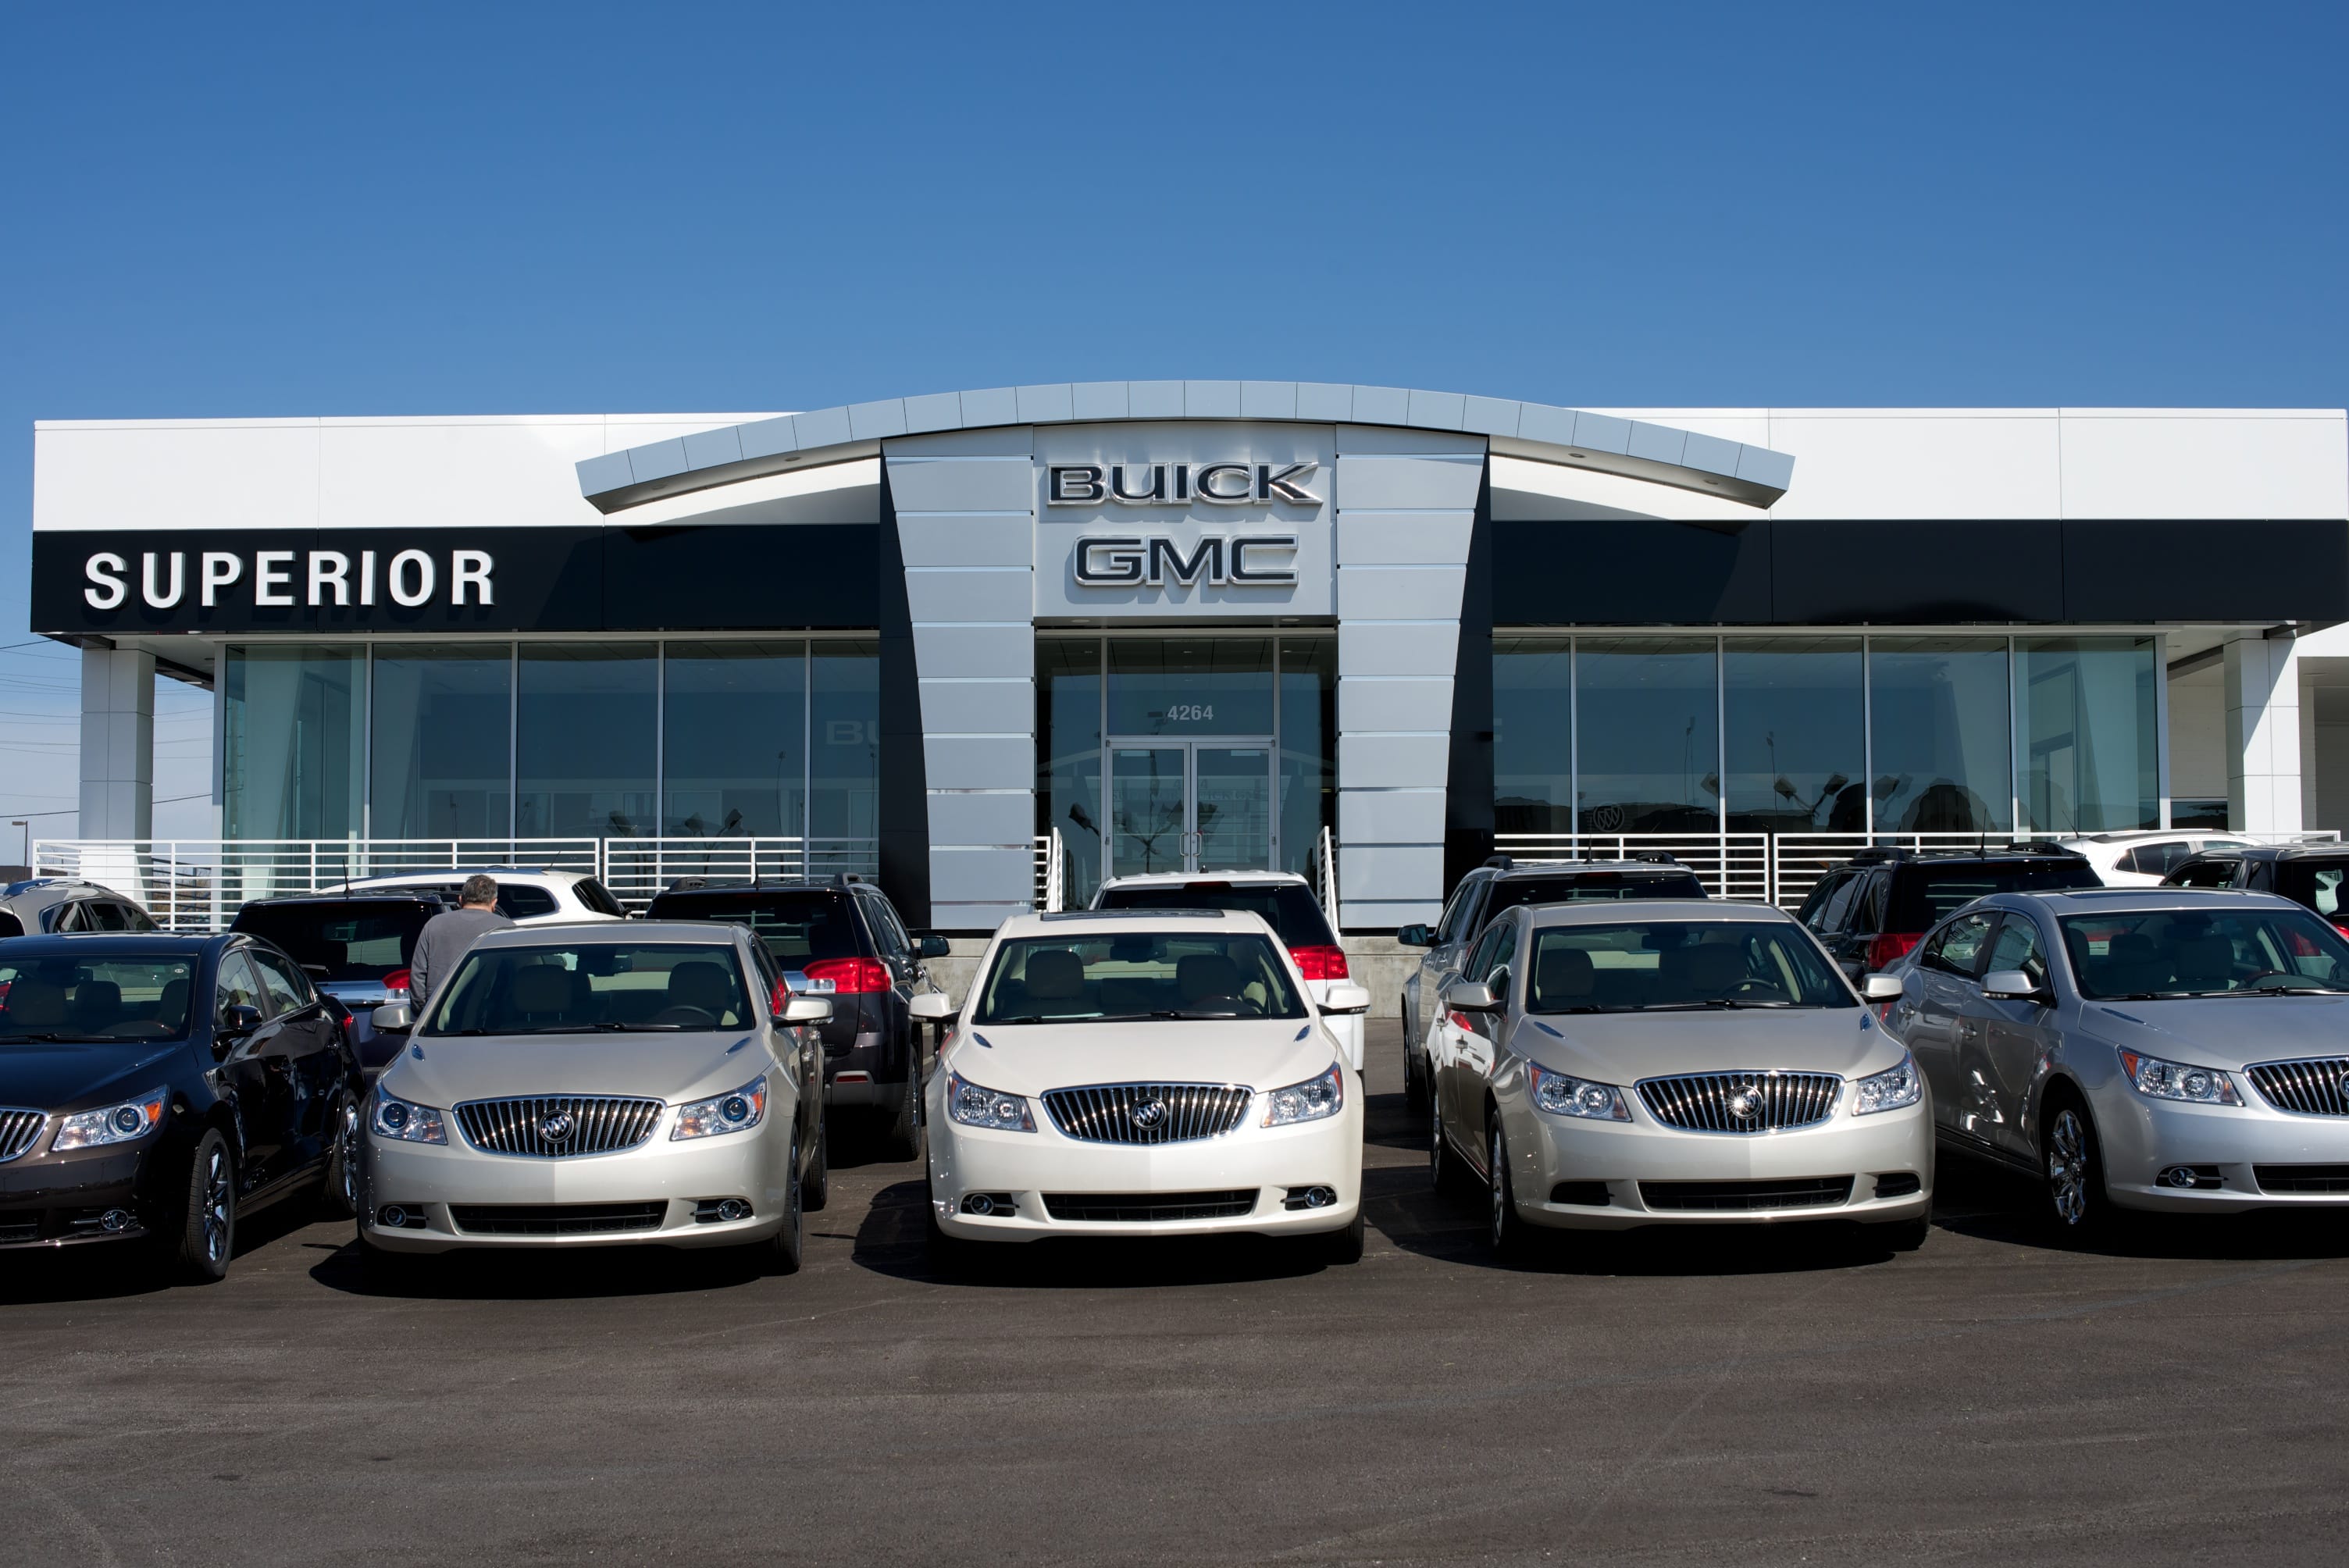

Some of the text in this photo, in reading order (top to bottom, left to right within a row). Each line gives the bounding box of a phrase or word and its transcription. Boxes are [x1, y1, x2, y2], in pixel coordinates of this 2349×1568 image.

[1046, 462, 1324, 506] BUICK
[84, 549, 495, 610] SUPERIOR
[1074, 534, 1299, 586] GMC
[1167, 705, 1214, 721] 4264
